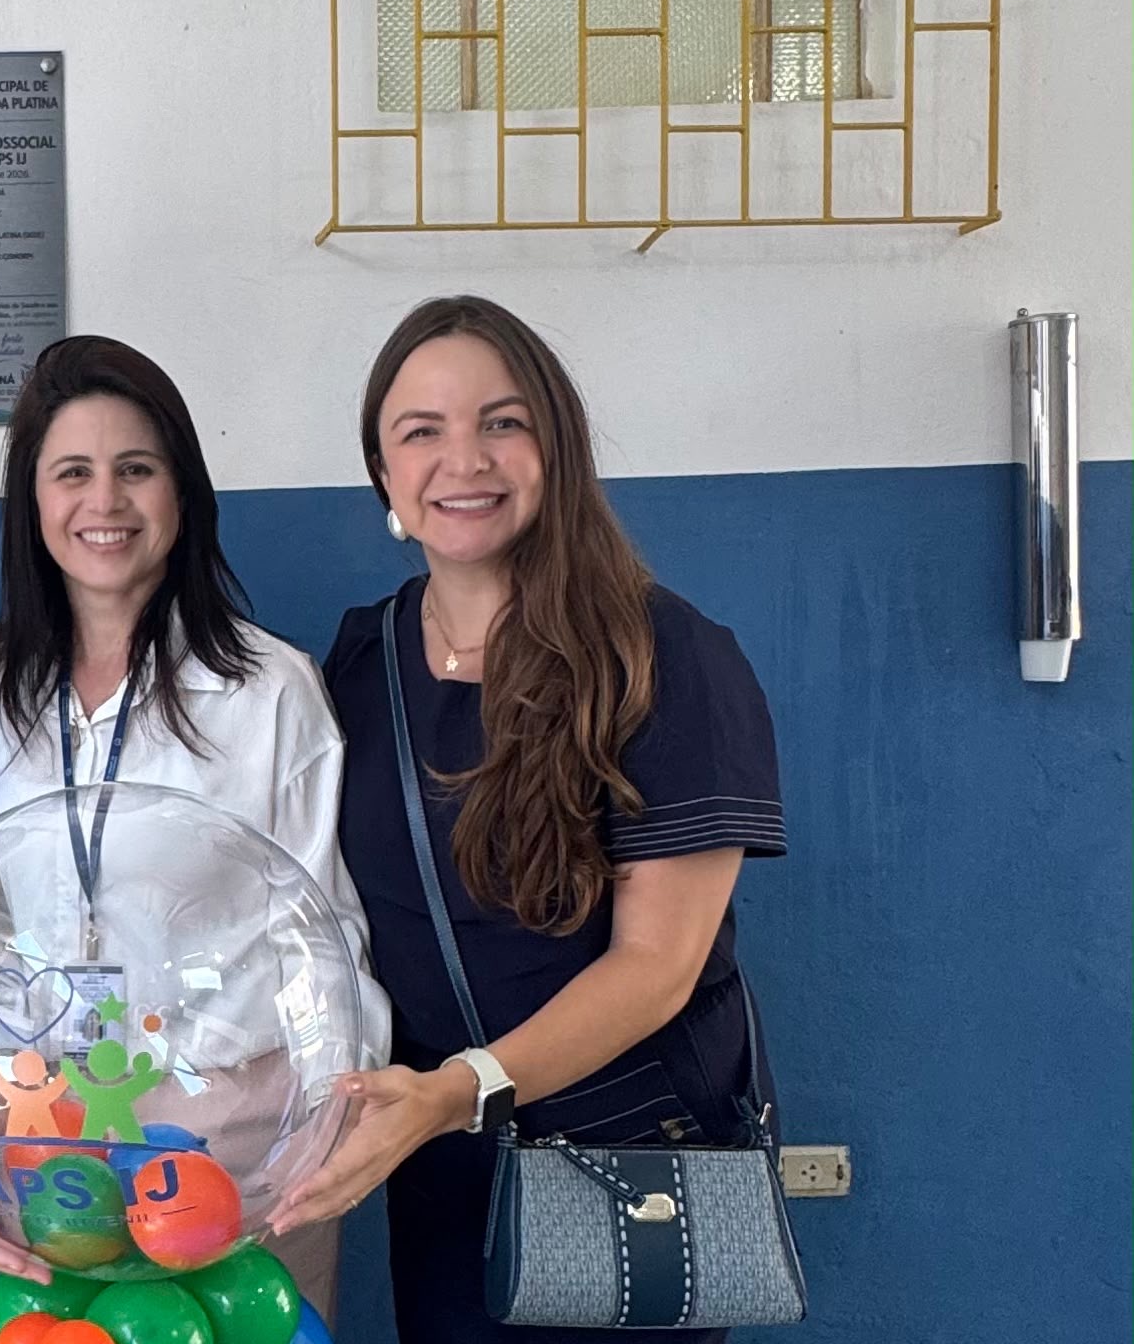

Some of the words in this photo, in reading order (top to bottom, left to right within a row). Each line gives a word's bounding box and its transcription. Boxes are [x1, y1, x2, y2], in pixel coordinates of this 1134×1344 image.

[33, 80, 49, 92] DE
[12, 97, 58, 109] PLATINA
[16, 152, 27, 165] IJ
[119, 1158, 180, 1207] IJ
